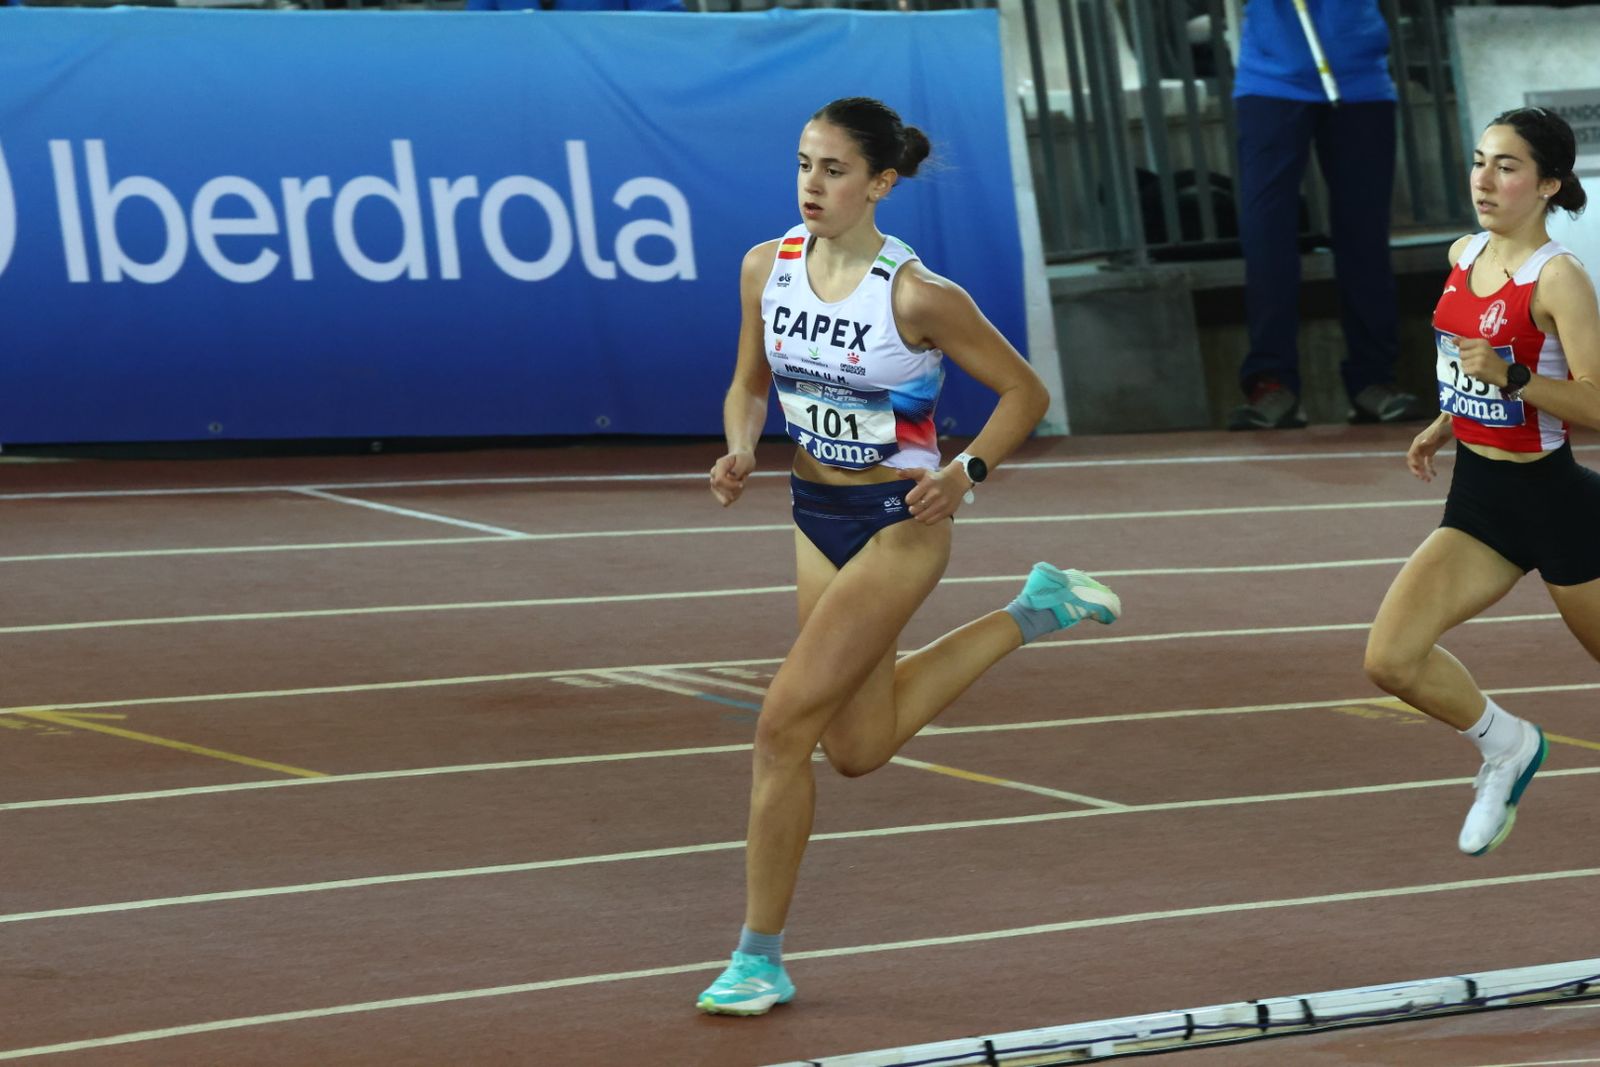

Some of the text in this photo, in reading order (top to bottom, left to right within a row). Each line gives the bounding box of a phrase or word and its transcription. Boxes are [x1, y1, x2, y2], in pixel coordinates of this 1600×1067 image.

[49, 139, 697, 284] Iberdrola
[773, 306, 872, 352] CAPEX
[806, 404, 858, 440] 101
